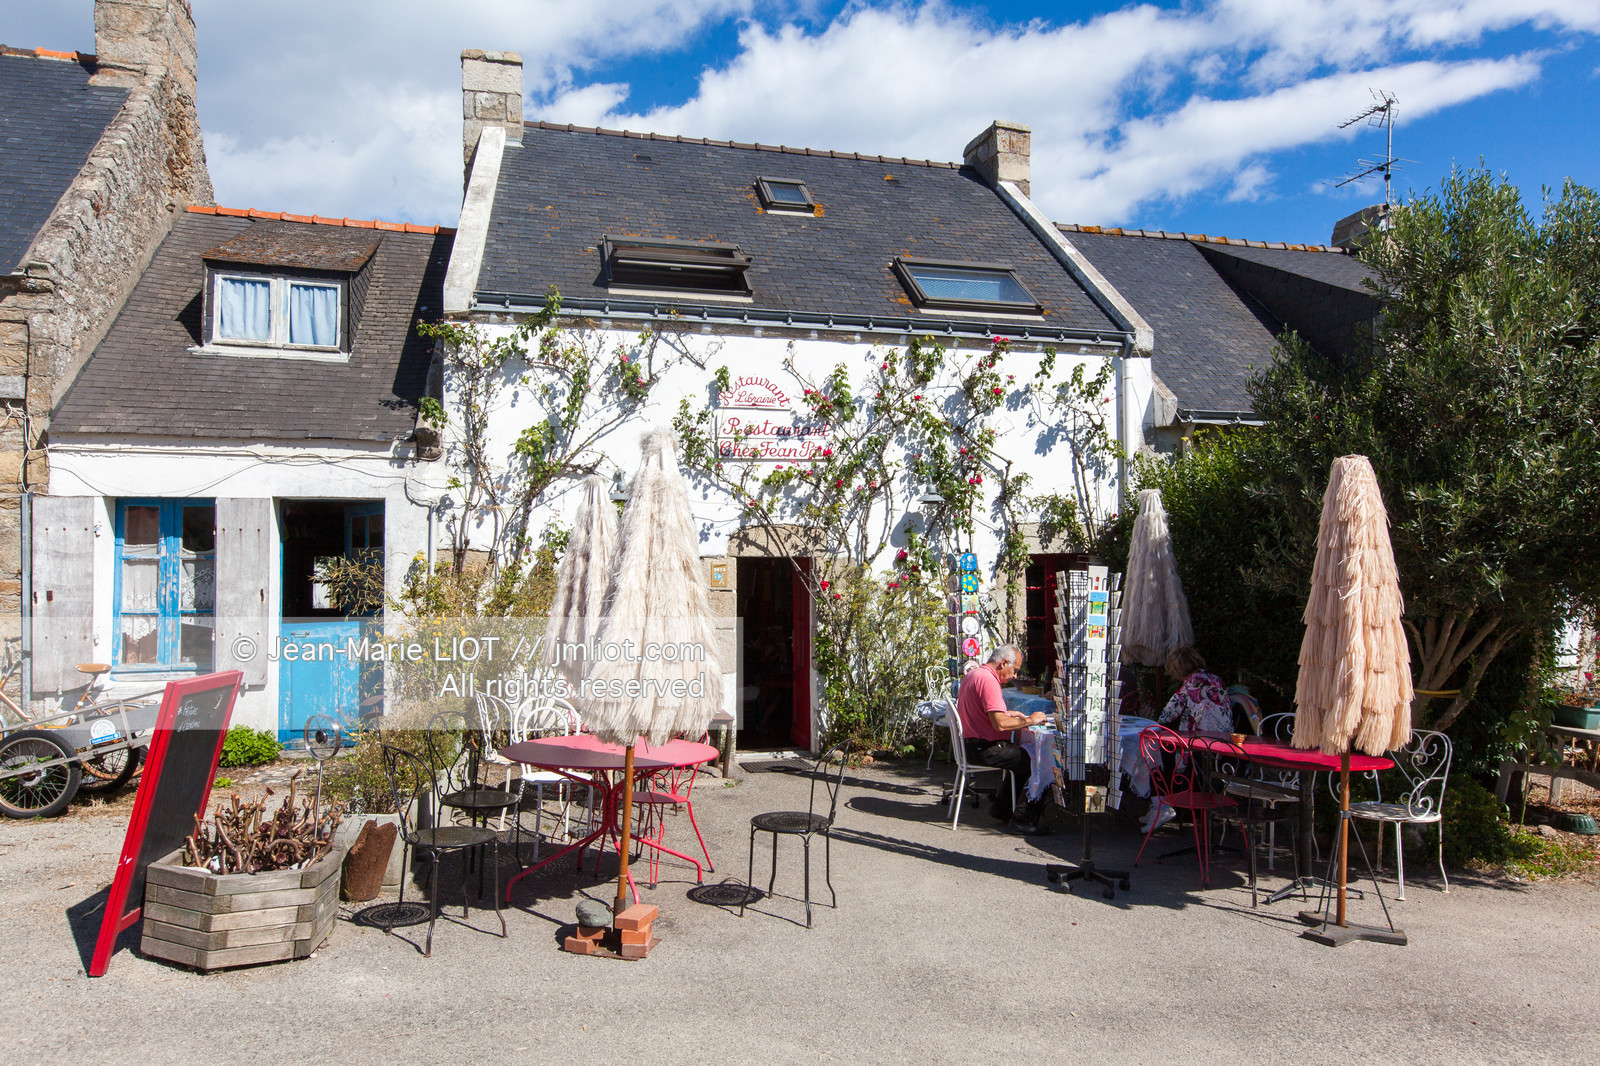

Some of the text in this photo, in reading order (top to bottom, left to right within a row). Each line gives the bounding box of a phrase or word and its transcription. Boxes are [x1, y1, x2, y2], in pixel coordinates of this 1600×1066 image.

[718, 375, 790, 407] Restaurant
[735, 390, 777, 404] Librairie
[722, 417, 831, 437] Restaurant
[719, 440, 758, 458] Chez
